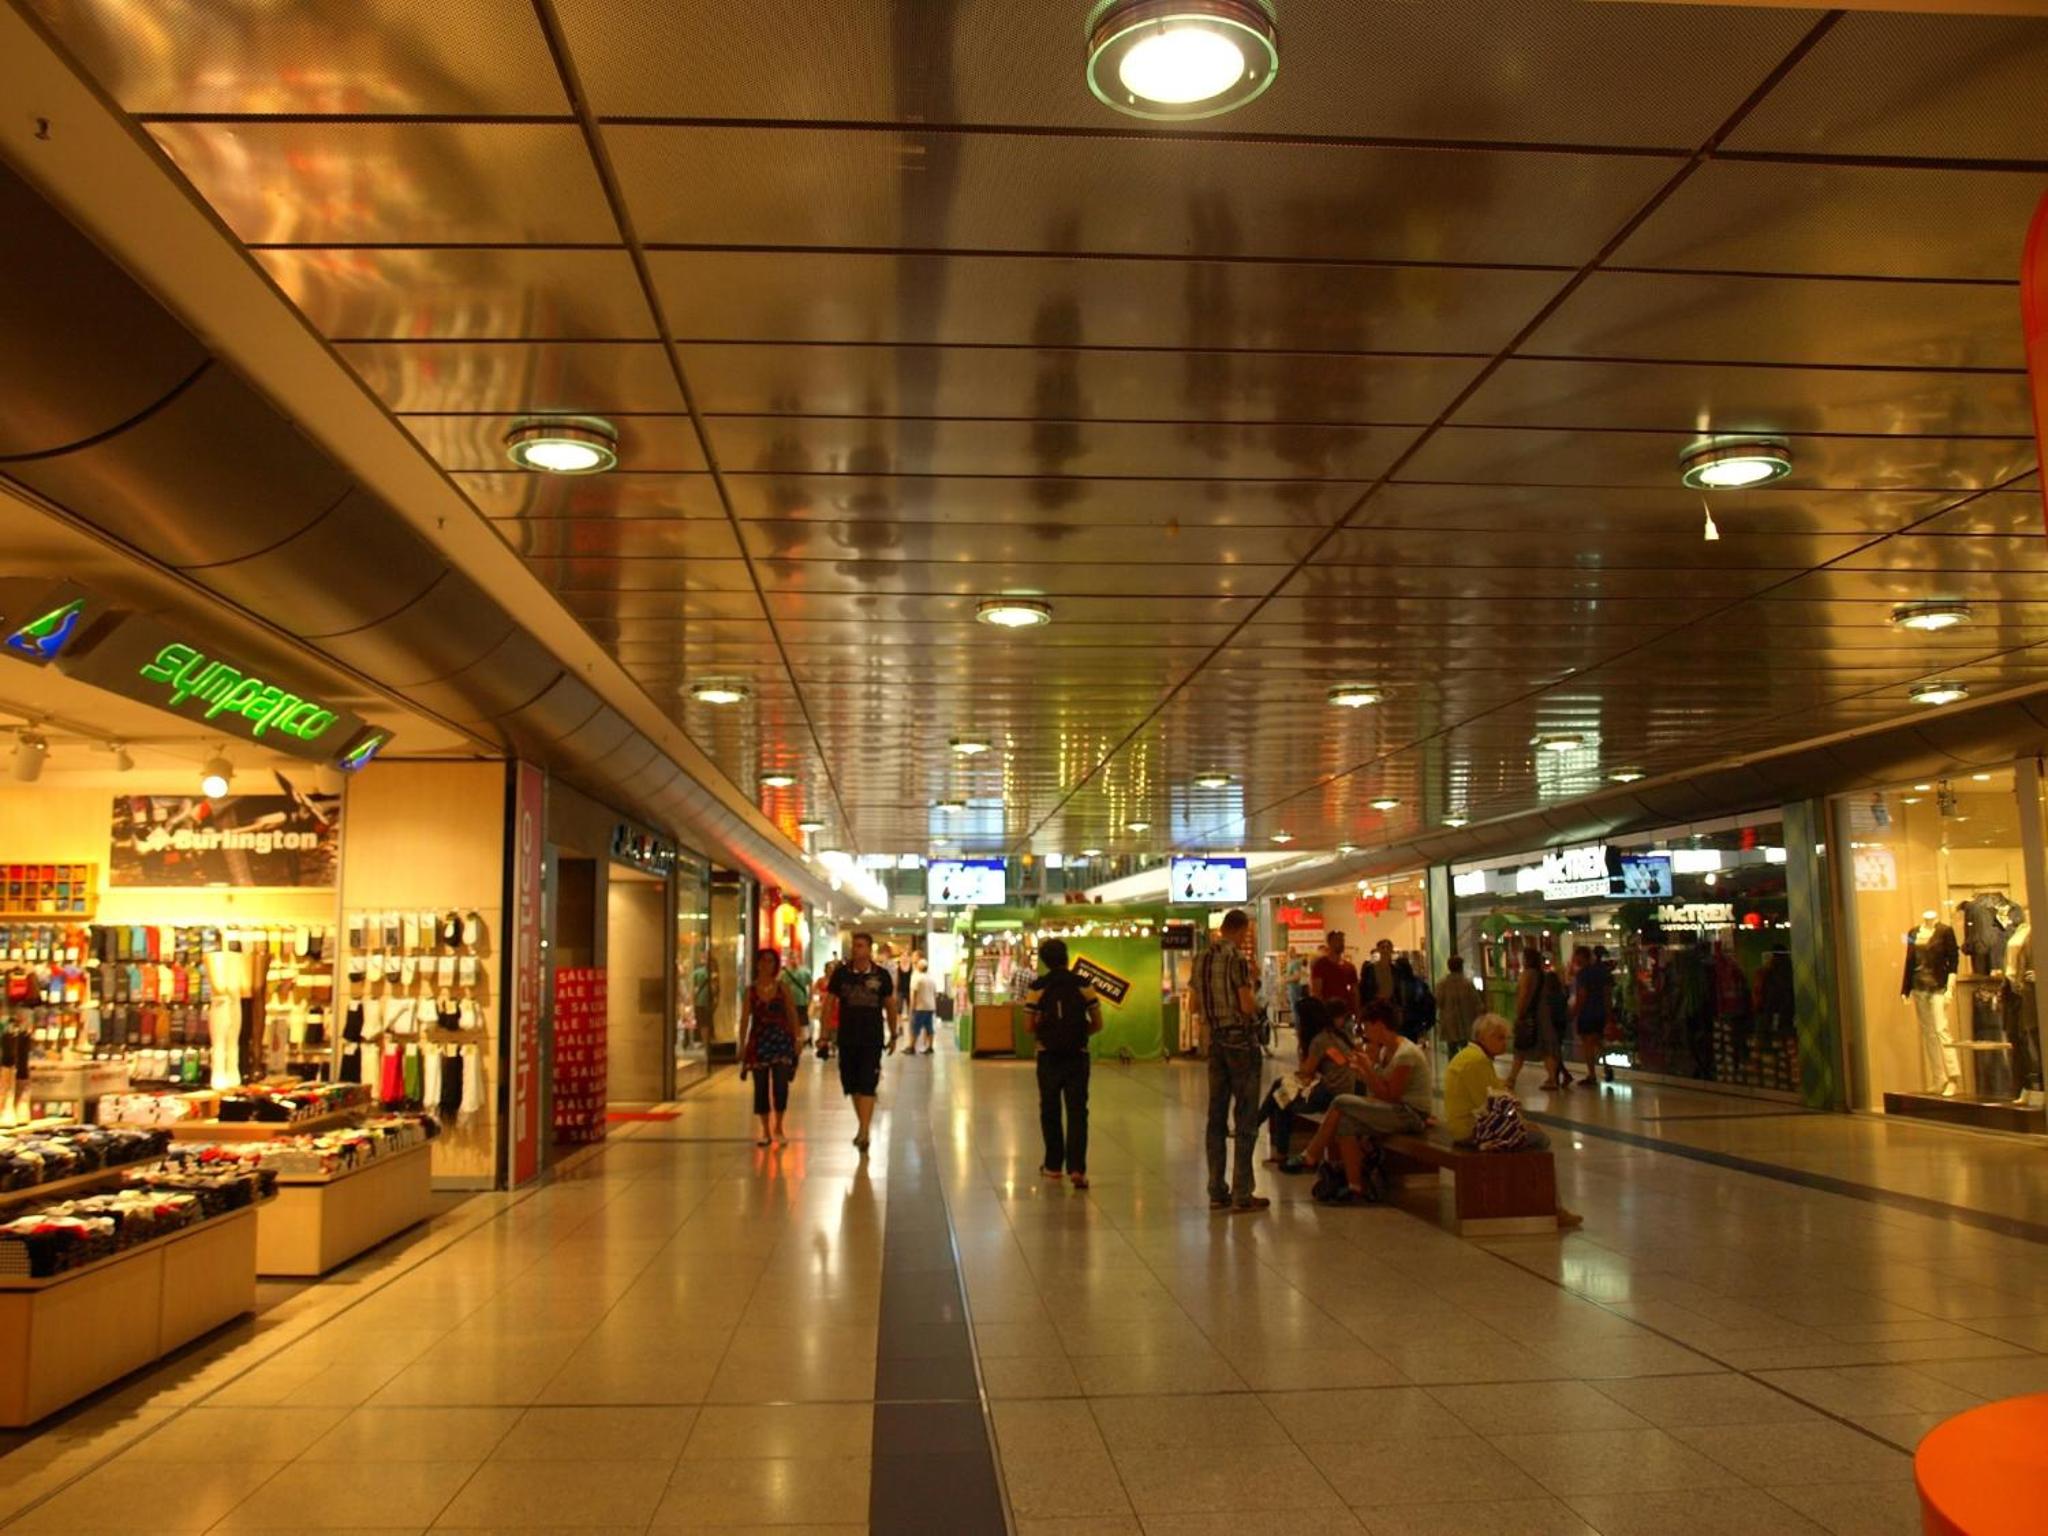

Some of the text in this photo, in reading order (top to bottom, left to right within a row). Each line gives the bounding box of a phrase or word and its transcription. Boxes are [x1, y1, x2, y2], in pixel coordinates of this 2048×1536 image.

[173, 829, 317, 854] Burlington
[1543, 845, 1609, 884] McTREK
[1658, 904, 1734, 922] McTREK
[559, 969, 594, 984] SALE
